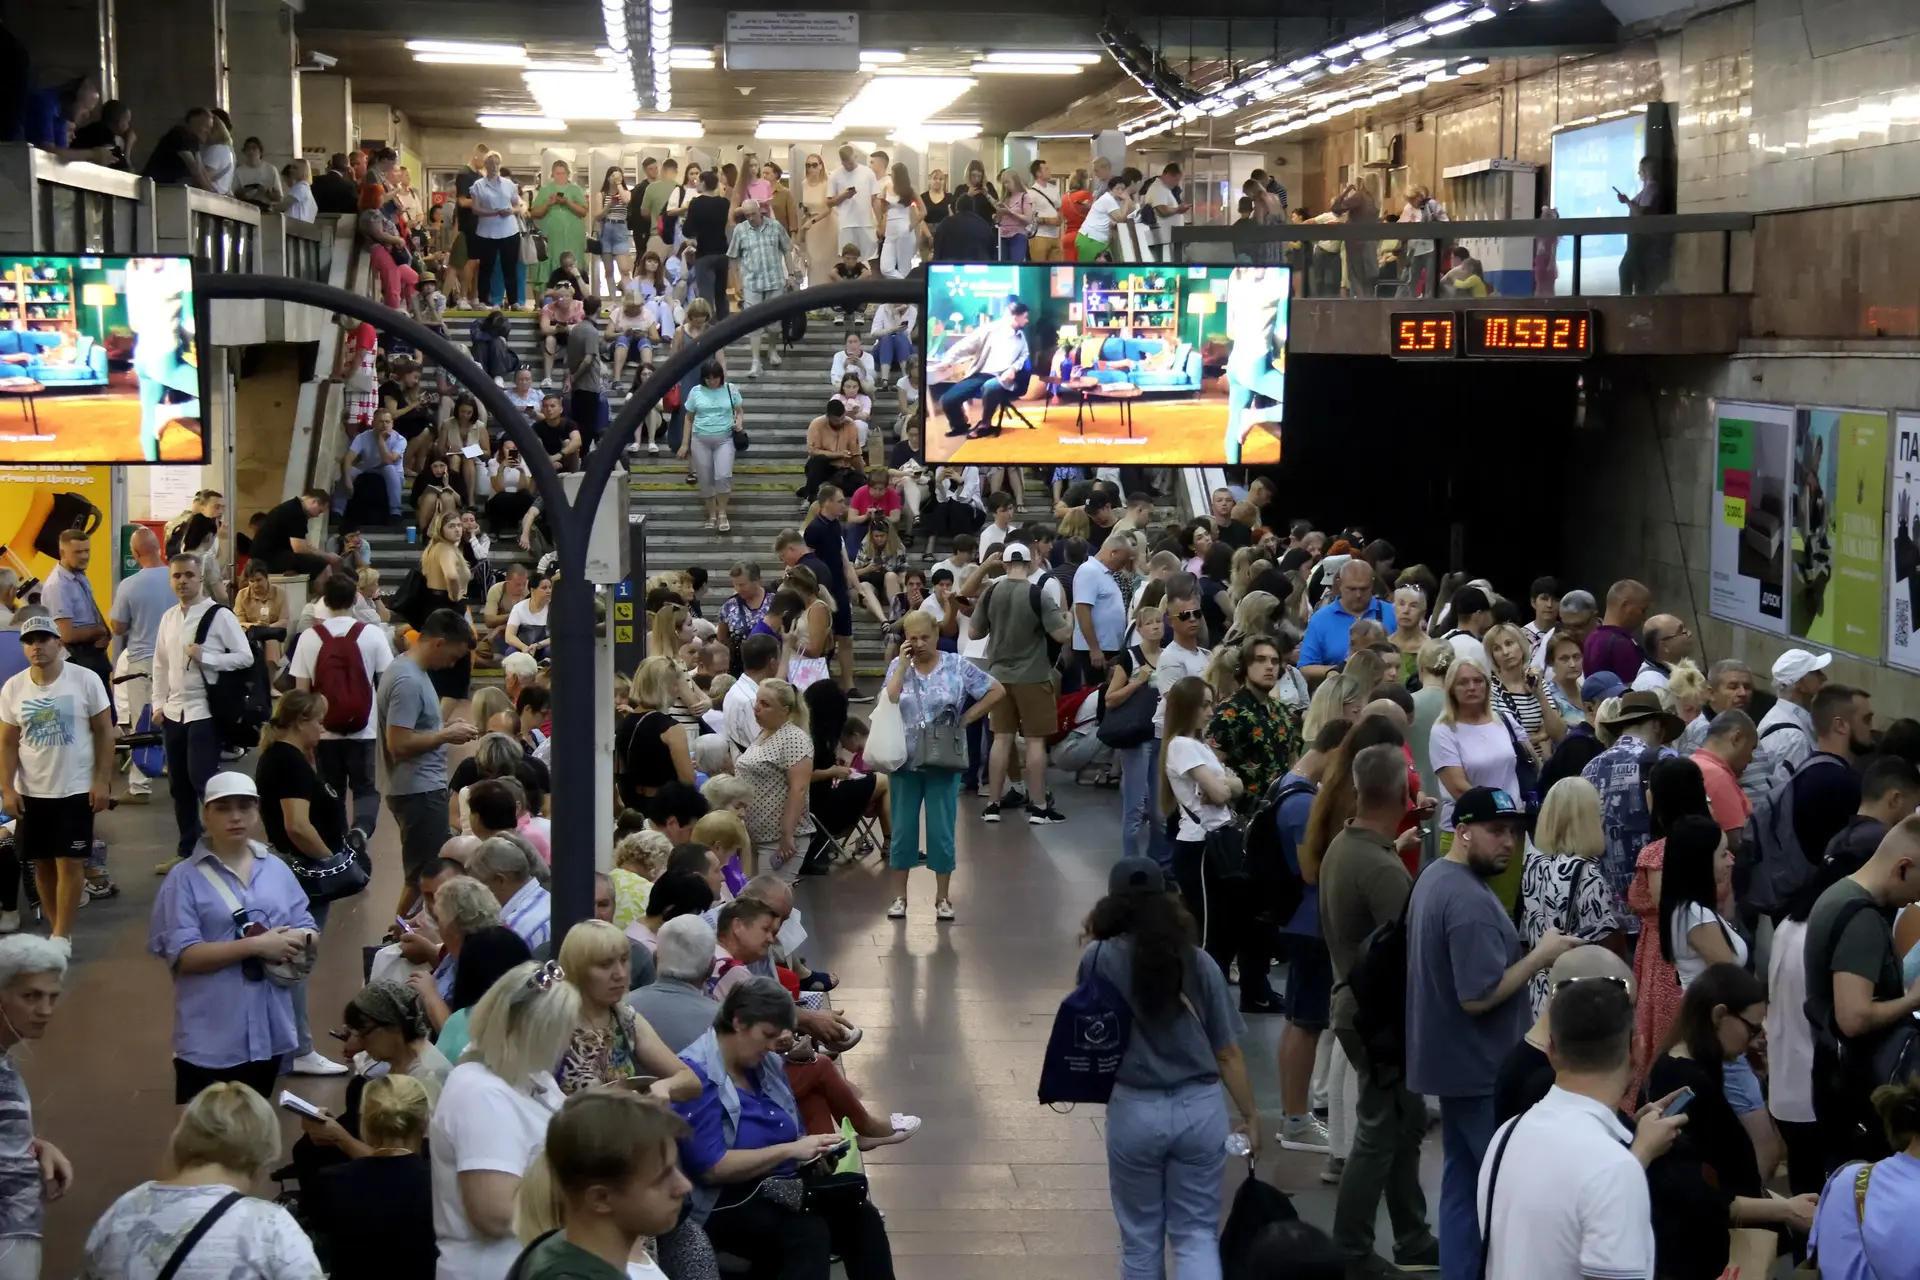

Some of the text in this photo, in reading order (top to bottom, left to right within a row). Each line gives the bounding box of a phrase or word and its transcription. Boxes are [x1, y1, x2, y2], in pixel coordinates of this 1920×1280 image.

[1400, 320, 1452, 349] 5.57
[1485, 318, 1587, 348] 10.53 21
